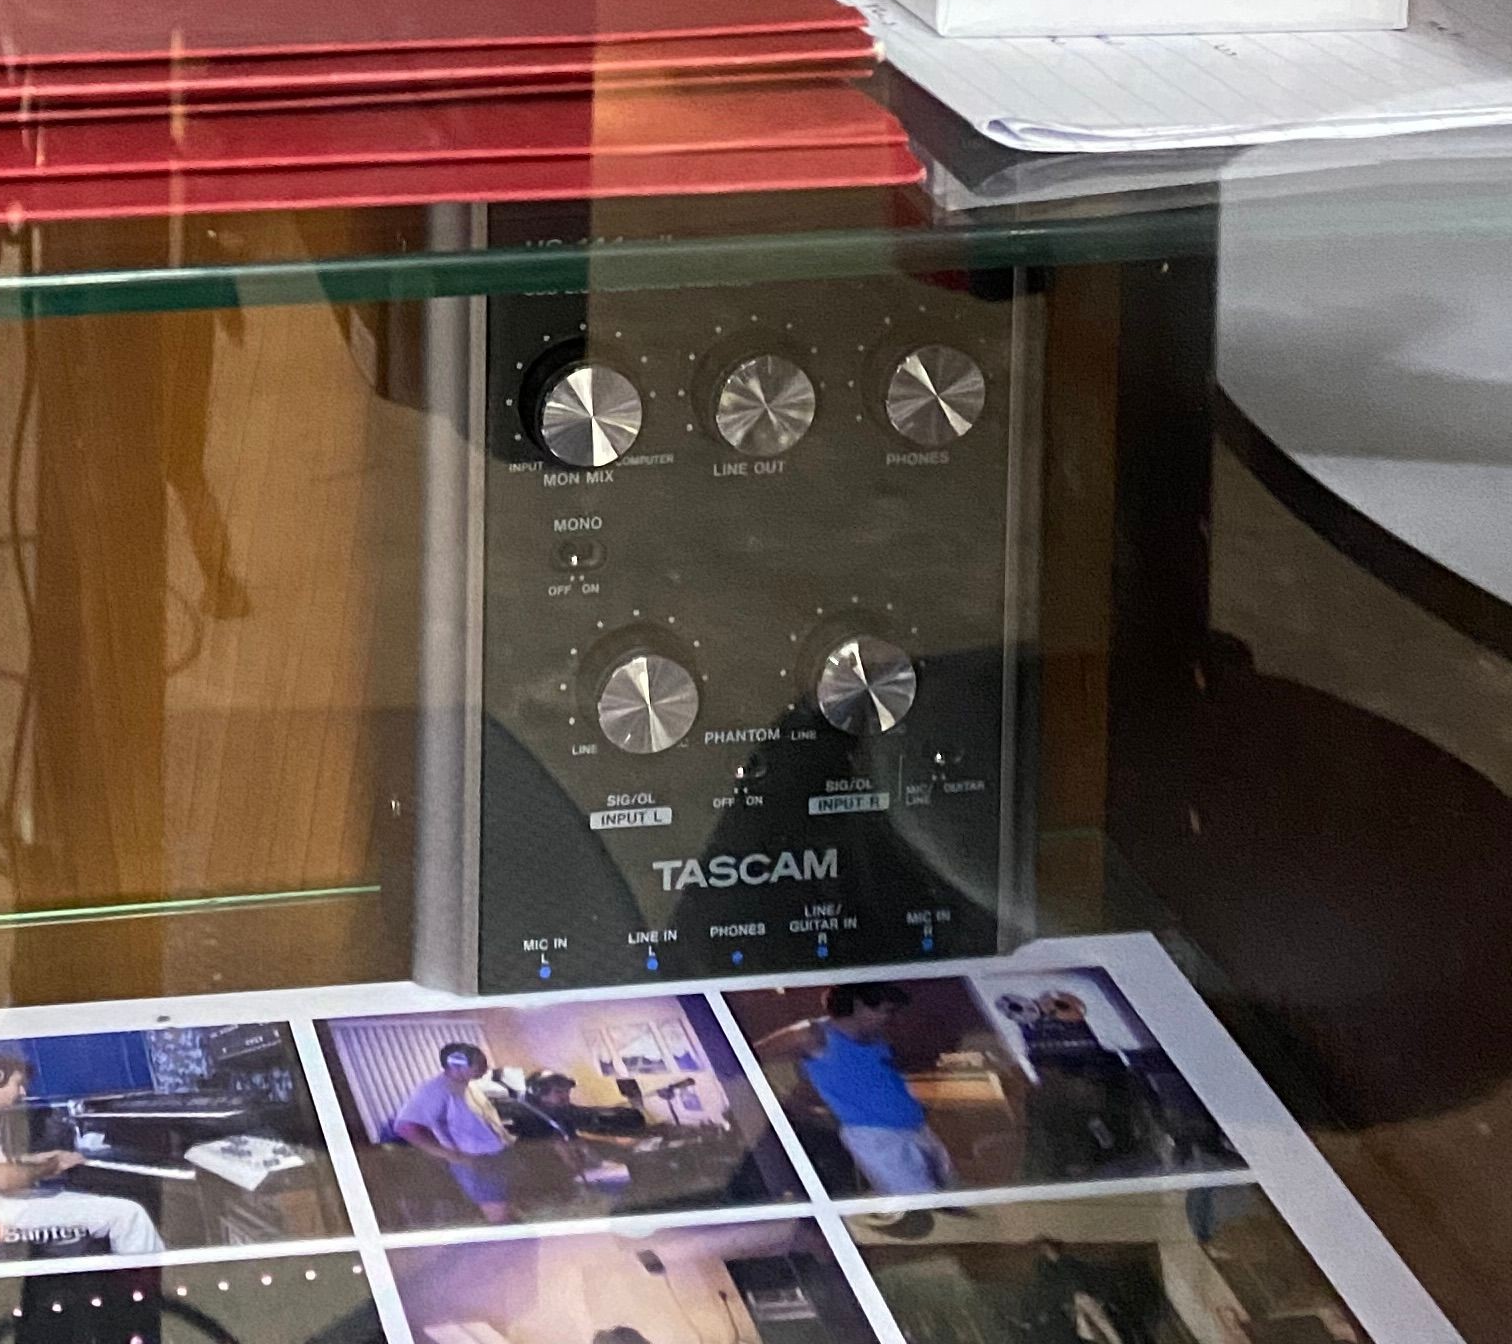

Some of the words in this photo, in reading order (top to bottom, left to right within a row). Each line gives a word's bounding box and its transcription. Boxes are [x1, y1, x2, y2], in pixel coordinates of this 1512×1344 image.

[886, 450, 950, 465] PHONES
[508, 461, 544, 473] INPUT
[713, 462, 748, 477] LINE
[754, 460, 785, 475] OUT
[543, 471, 580, 487] MON
[586, 469, 614, 484] MIX
[553, 516, 603, 532] MONO
[547, 583, 572, 597] OFF
[581, 581, 600, 595] ON
[704, 728, 781, 745] PHANTOM
[712, 797, 736, 809] OFF
[745, 795, 764, 807] ON
[817, 798, 861, 811] INPUT
[600, 813, 646, 827] INPUT
[653, 812, 663, 823] L
[651, 848, 839, 892] TASCAM
[709, 922, 767, 938] PHONES
[789, 917, 839, 932] GUITAR
[843, 915, 858, 930] IN
[522, 938, 549, 952] MIC
[553, 937, 569, 950] IN
[627, 931, 659, 945] LINE
[663, 929, 679, 942] IN
[540, 953, 550, 965] L
[648, 945, 657, 957] L
